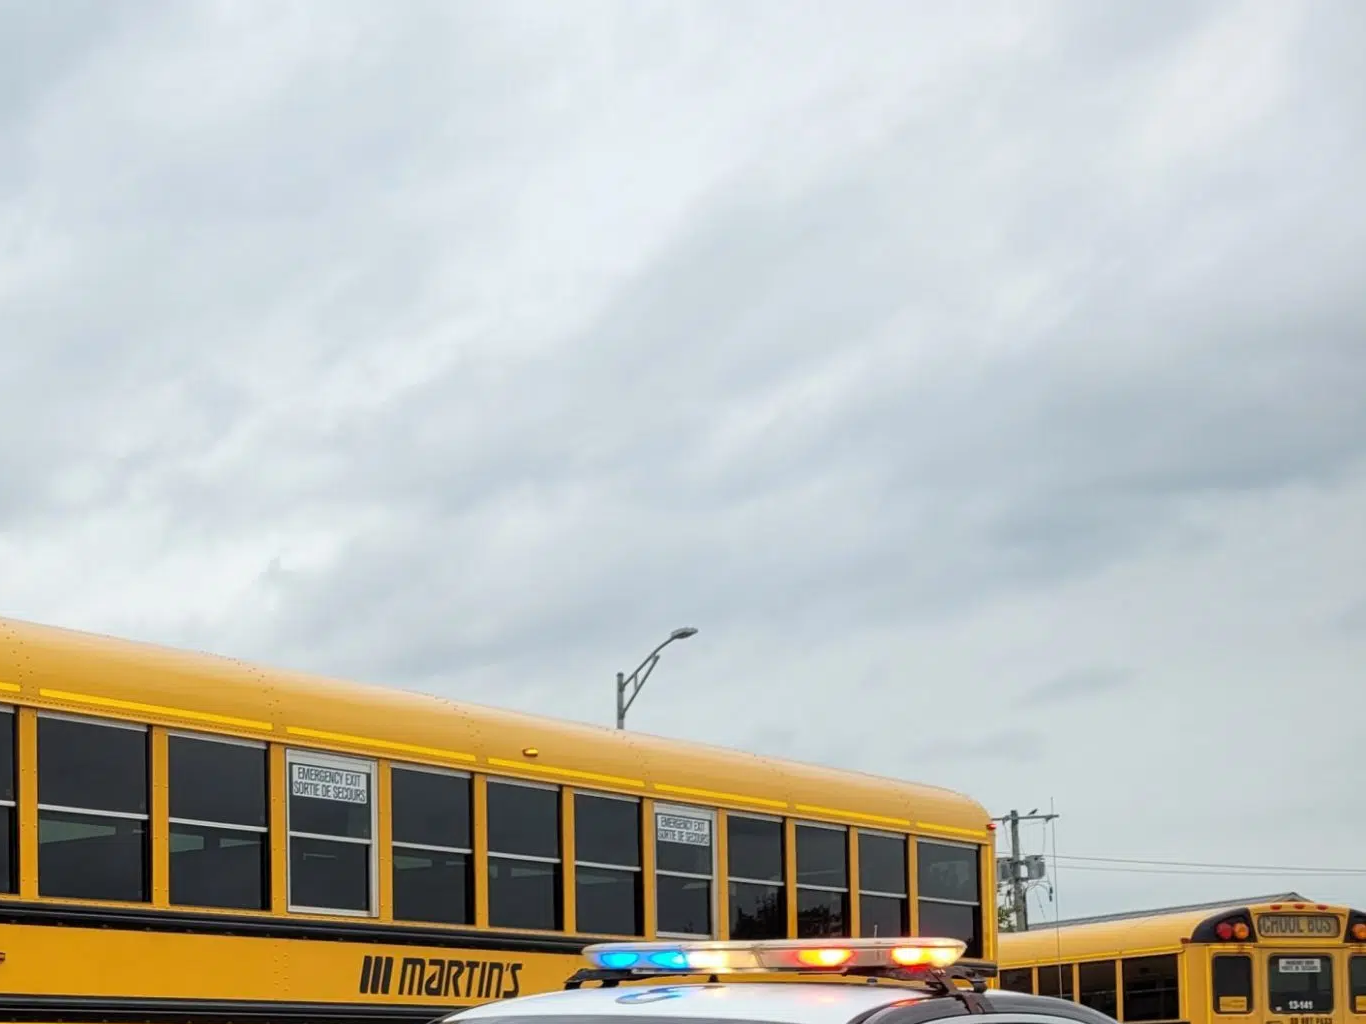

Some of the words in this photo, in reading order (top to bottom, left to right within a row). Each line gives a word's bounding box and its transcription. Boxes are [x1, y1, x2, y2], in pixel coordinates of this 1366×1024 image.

[297, 766, 344, 785] EMERGENCY
[345, 773, 361, 788] EXIT
[294, 781, 320, 796] SORTIE
[321, 784, 331, 798] DE
[333, 786, 366, 802] SECOURS
[1308, 917, 1331, 933] BUS
[1288, 1000, 1314, 1010] 13-141
[1316, 1017, 1332, 1024] PASS
